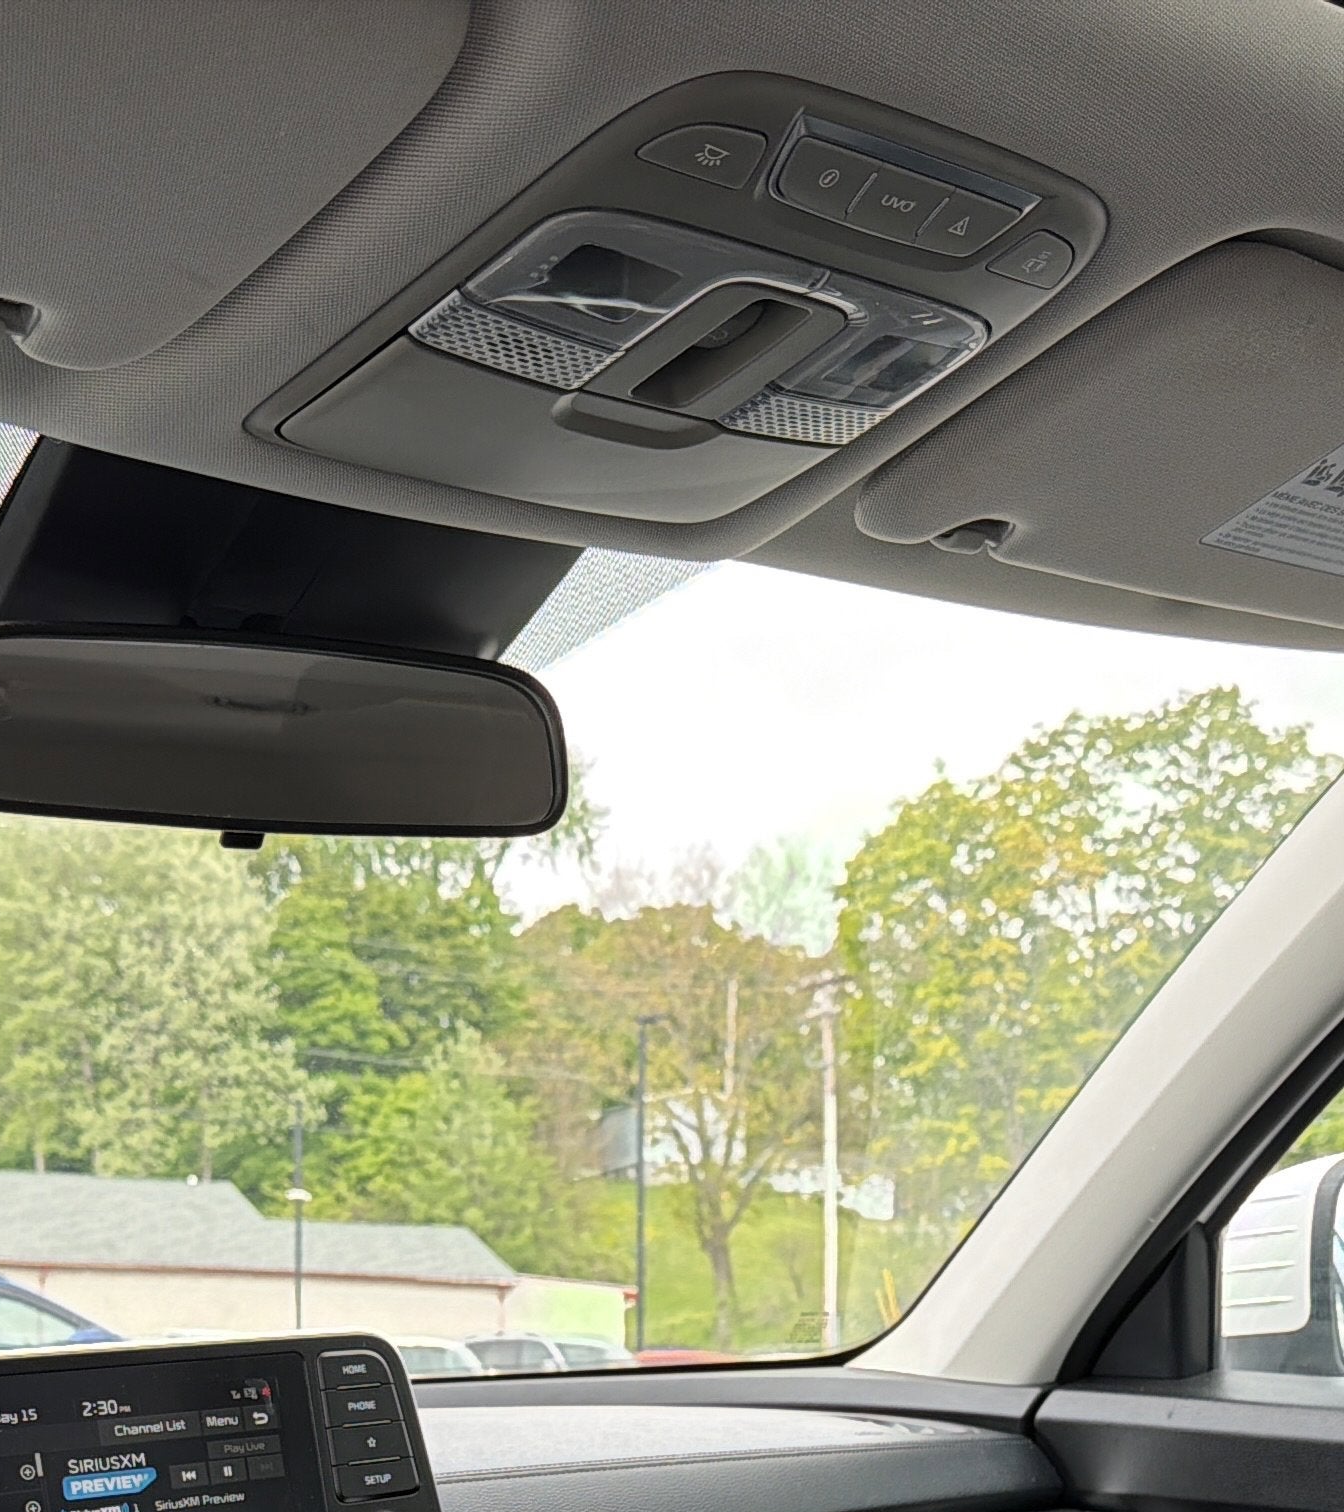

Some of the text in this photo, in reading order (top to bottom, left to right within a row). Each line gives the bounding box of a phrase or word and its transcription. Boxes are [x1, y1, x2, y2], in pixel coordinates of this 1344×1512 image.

[881, 194, 916, 212] UVO
[342, 1364, 367, 1375] HOME
[82, 1399, 119, 1417] 2:30
[348, 1400, 376, 1411] PHONE
[21, 1408, 38, 1422] 15
[206, 1415, 239, 1428] Menu
[114, 1419, 187, 1438] Channel List
[224, 1441, 266, 1455] Play Live
[68, 1453, 147, 1475] SIRIUSXM
[70, 1474, 149, 1495] PREVIEW
[364, 1474, 392, 1485] SETUP
[155, 1493, 245, 1511] SiriusXM Preview
